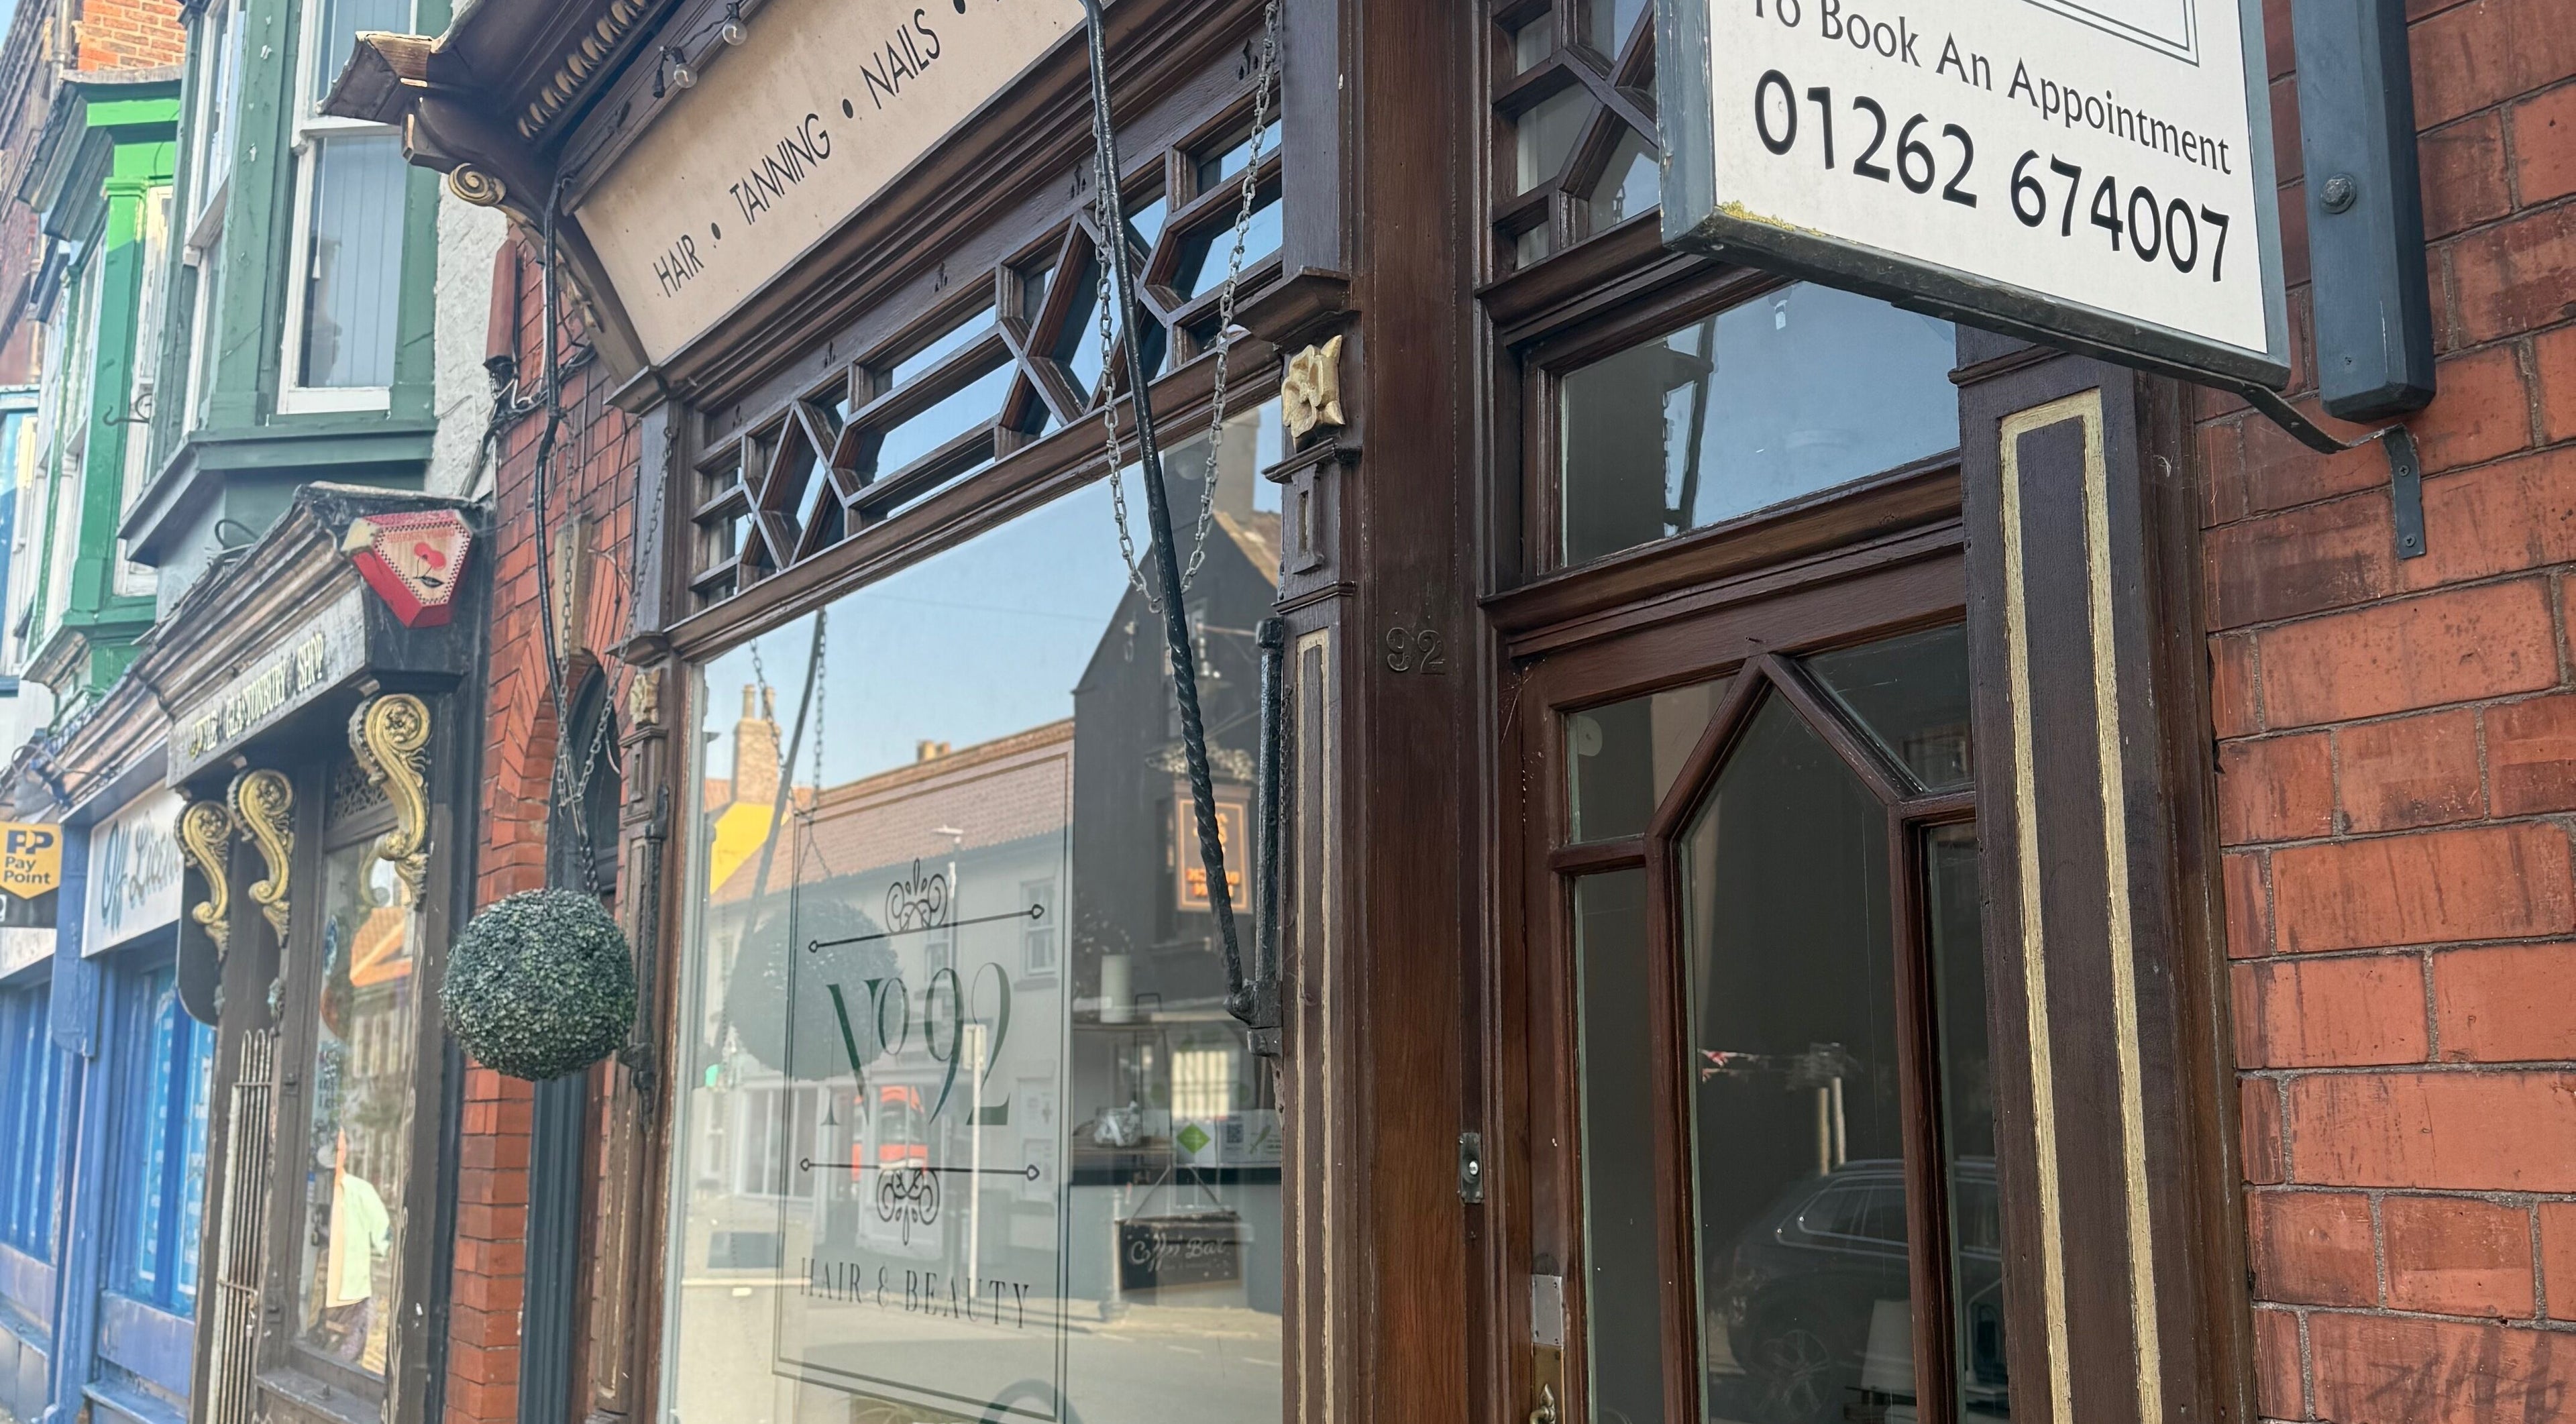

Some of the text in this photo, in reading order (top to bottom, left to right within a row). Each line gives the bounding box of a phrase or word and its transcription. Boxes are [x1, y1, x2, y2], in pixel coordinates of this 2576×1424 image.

[1821, 0, 1922, 68] Book
[1935, 32, 1992, 91] An
[2007, 56, 2232, 175] Appointment
[653, 8, 941, 298] HAIR TANNING NAILS
[1754, 69, 2230, 282] 01262 674007
[297, 633, 324, 692] SHOP
[1387, 627, 1446, 675] 92
[3, 870, 51, 885] Point
[5, 856, 37, 873] Pay
[800, 1256, 862, 1304] HAIR
[906, 1268, 1030, 1329] BEAUTY
